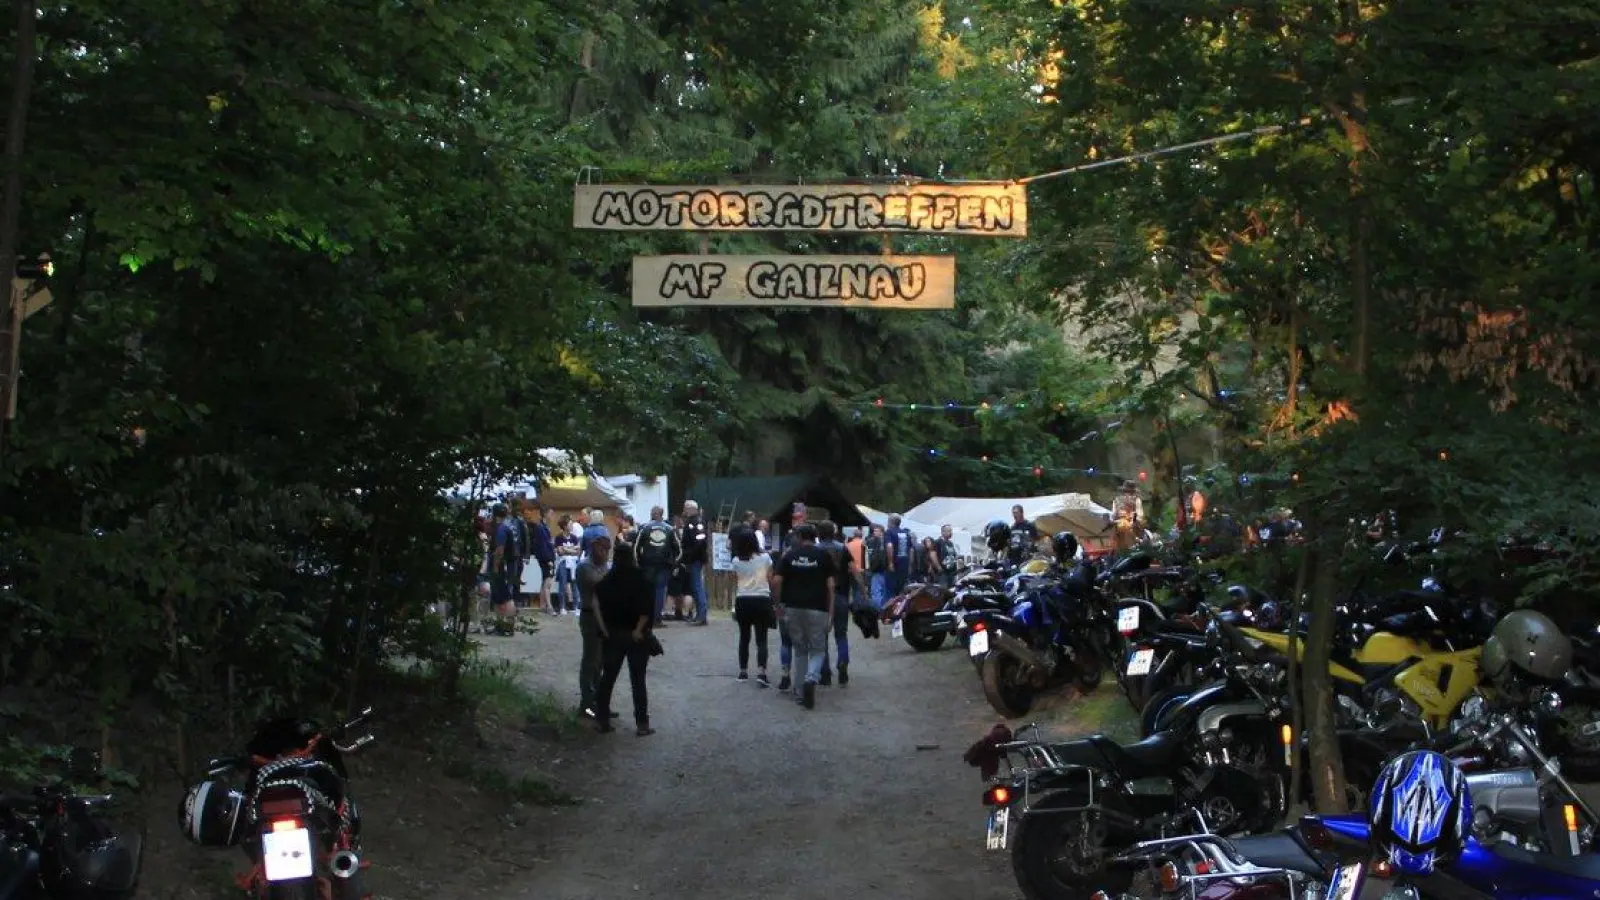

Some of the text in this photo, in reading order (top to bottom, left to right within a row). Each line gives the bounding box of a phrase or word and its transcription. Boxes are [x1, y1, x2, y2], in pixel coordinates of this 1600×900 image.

[593, 189, 1013, 231] MOTORRADTREFFEN
[660, 261, 926, 299] MF GAILNAU
